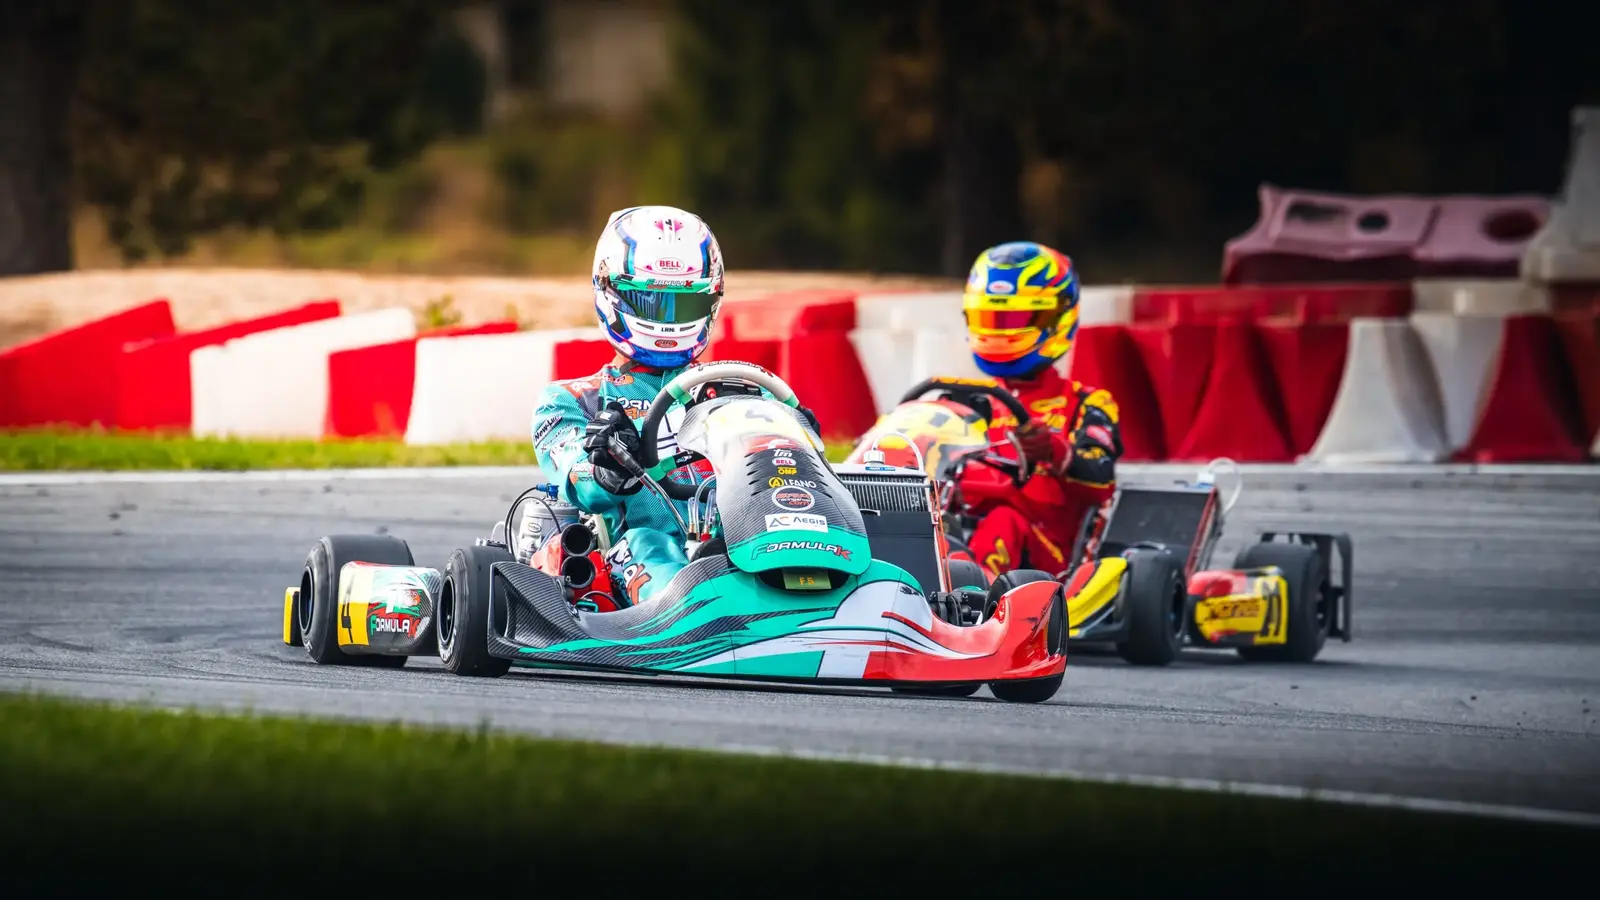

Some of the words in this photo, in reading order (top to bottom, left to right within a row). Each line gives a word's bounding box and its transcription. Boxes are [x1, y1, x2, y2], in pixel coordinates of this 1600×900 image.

[659, 260, 681, 268] BELL
[777, 466, 798, 475] OMP
[792, 516, 826, 526] AEGIS
